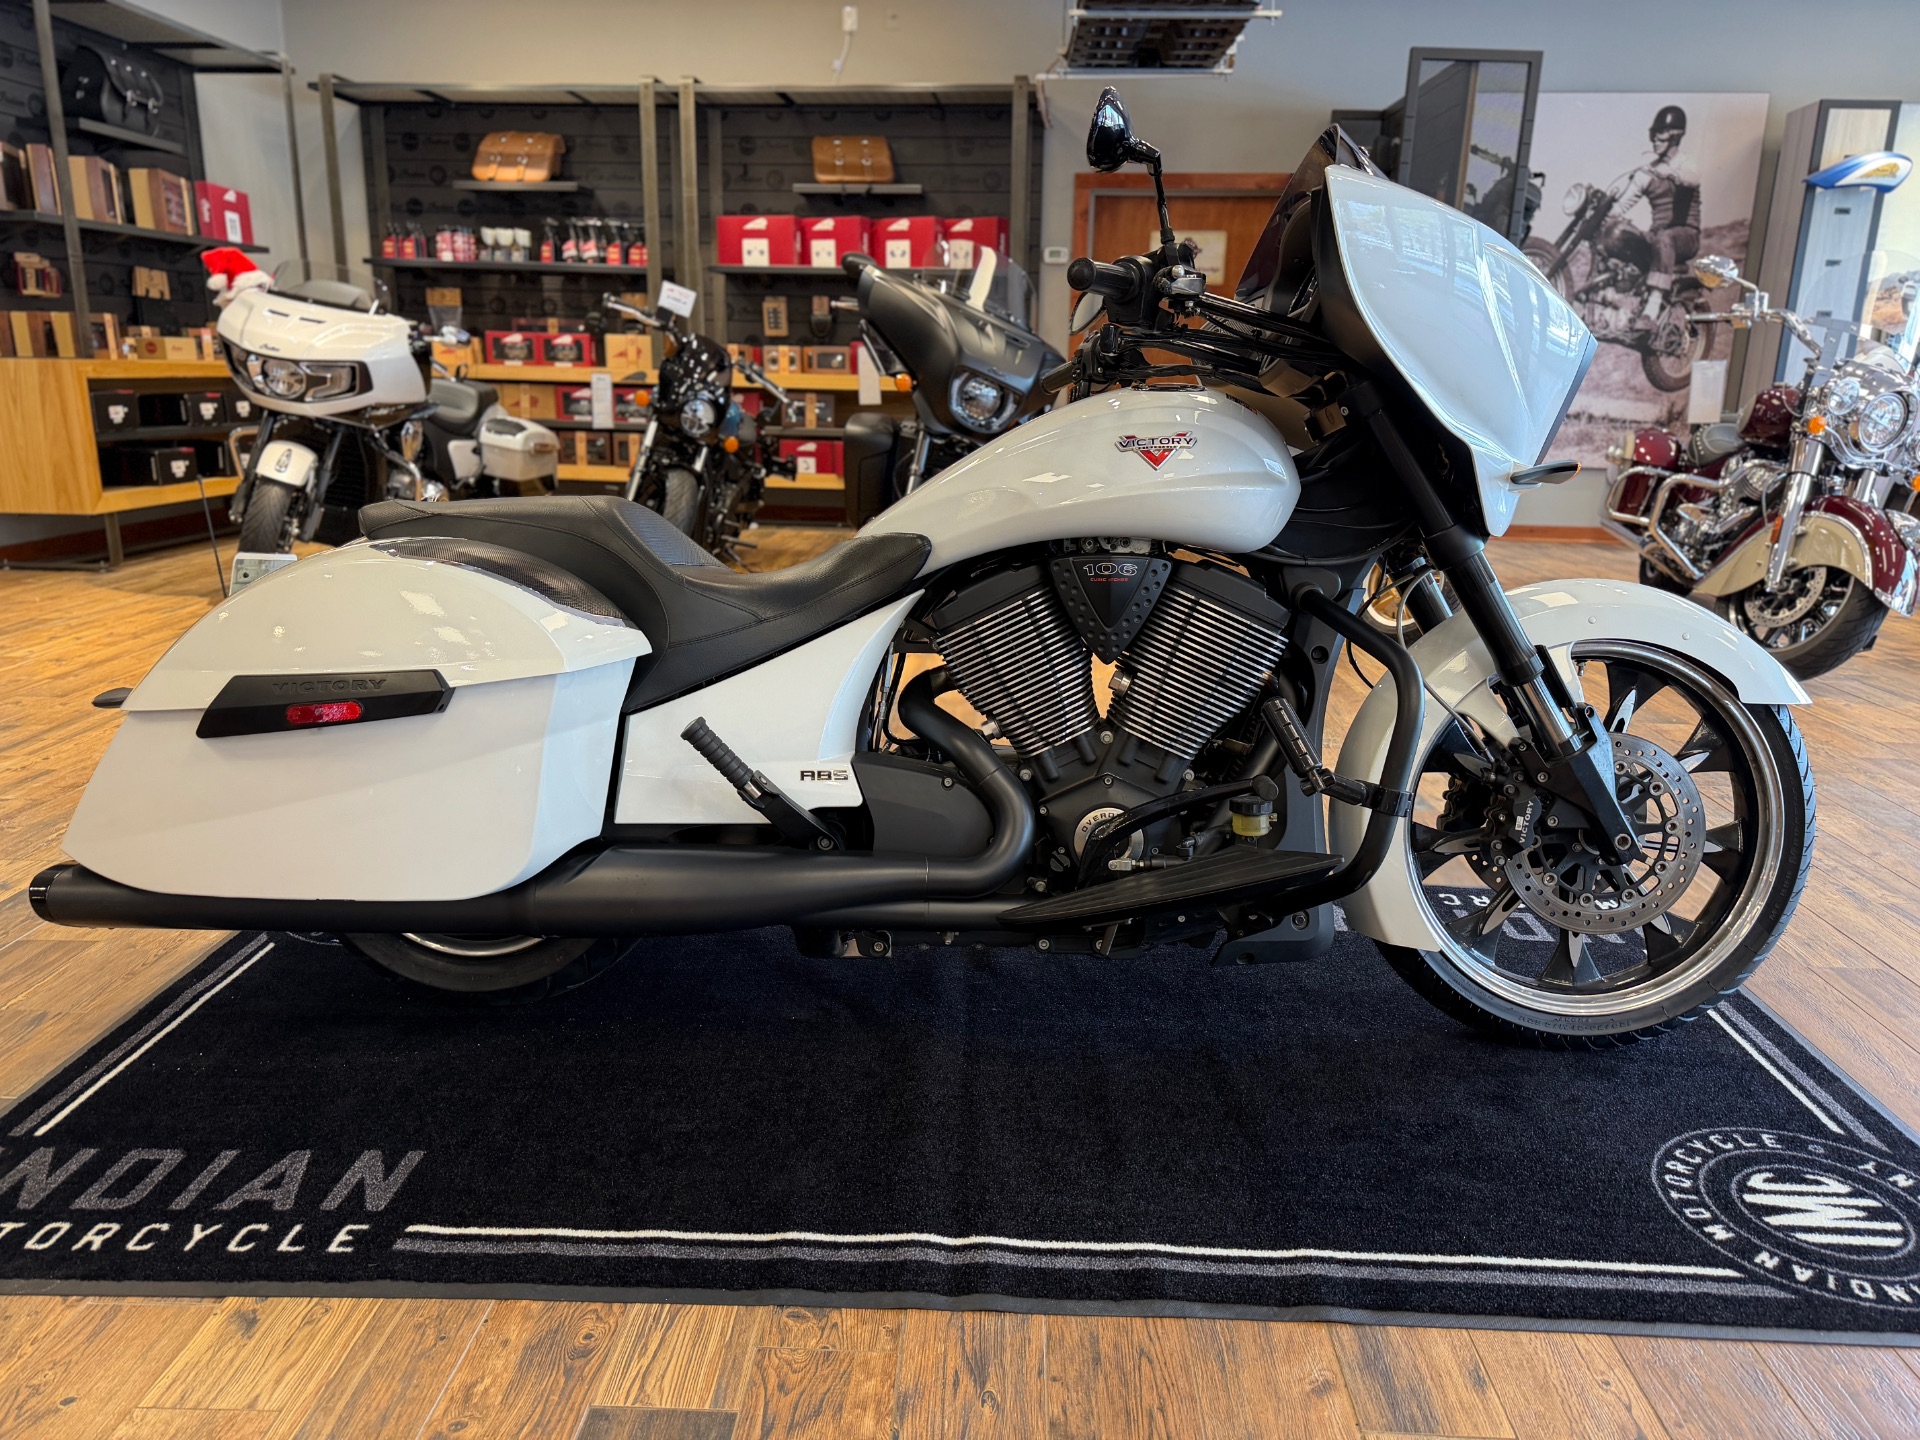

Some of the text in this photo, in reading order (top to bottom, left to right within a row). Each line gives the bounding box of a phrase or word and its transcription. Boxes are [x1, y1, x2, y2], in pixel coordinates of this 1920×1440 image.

[1119, 437, 1193, 448] VICTORY
[1083, 562, 1138, 576] 106
[272, 679, 387, 694] VICTORY
[800, 770, 848, 781] ABS
[1081, 812, 1117, 833] OVERD
[1519, 800, 1534, 843] VICTORY
[0, 1147, 426, 1211] NDIAN
[1664, 1134, 1782, 1241] MOTORCYCLE
[0, 1222, 371, 1252] TORCYCLE
